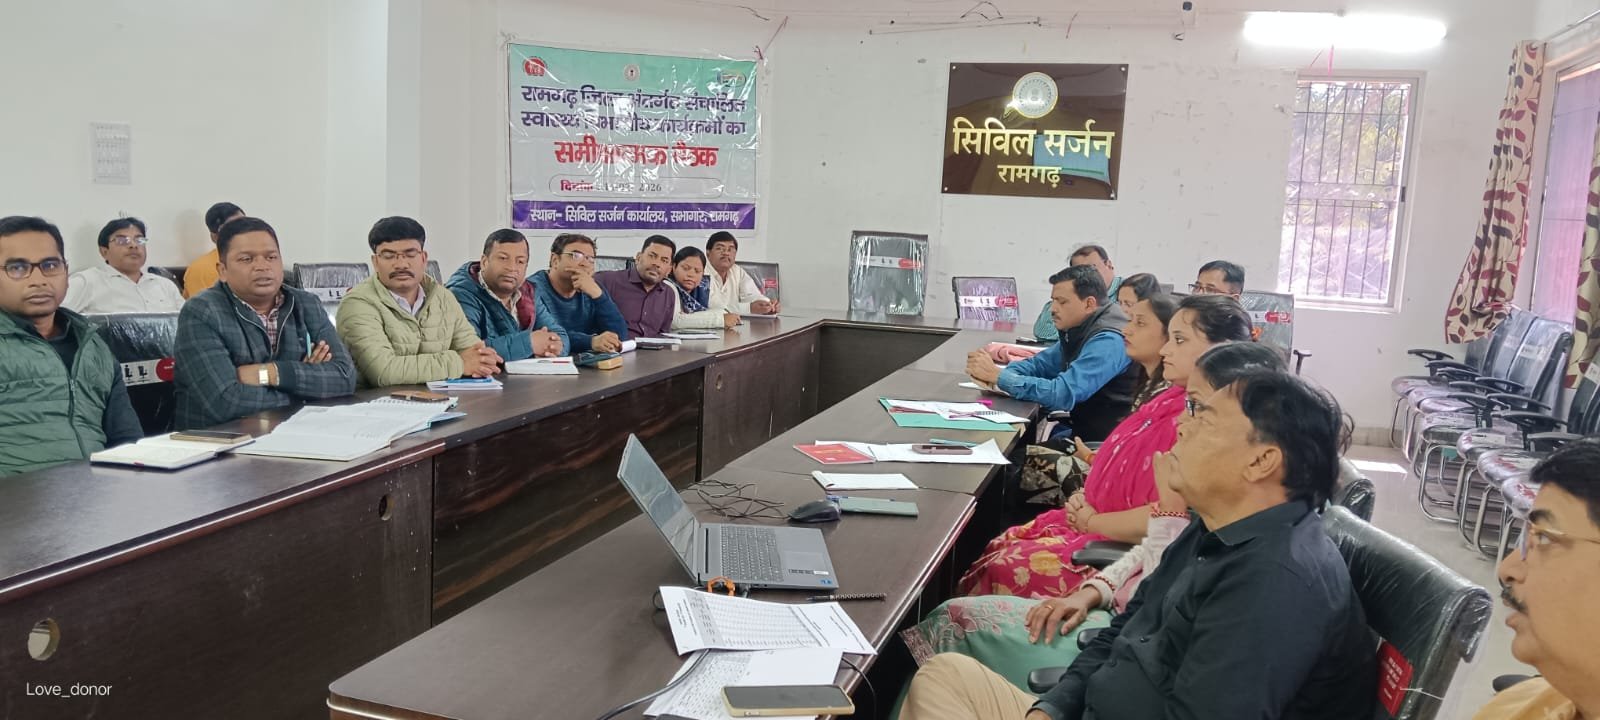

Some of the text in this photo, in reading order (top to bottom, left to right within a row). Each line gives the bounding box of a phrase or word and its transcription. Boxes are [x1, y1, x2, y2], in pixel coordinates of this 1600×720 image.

[521, 85, 578, 109] रामगढ़
[684, 91, 746, 112] संचालित
[726, 121, 746, 135] का
[952, 116, 1115, 159] सिविल सर्जन
[997, 164, 1062, 188] रामगढ़
[565, 205, 597, 222] सिविल
[598, 205, 625, 222] सर्जन
[626, 205, 668, 223] कार्यालय,
[709, 210, 740, 226] रामगढ़
